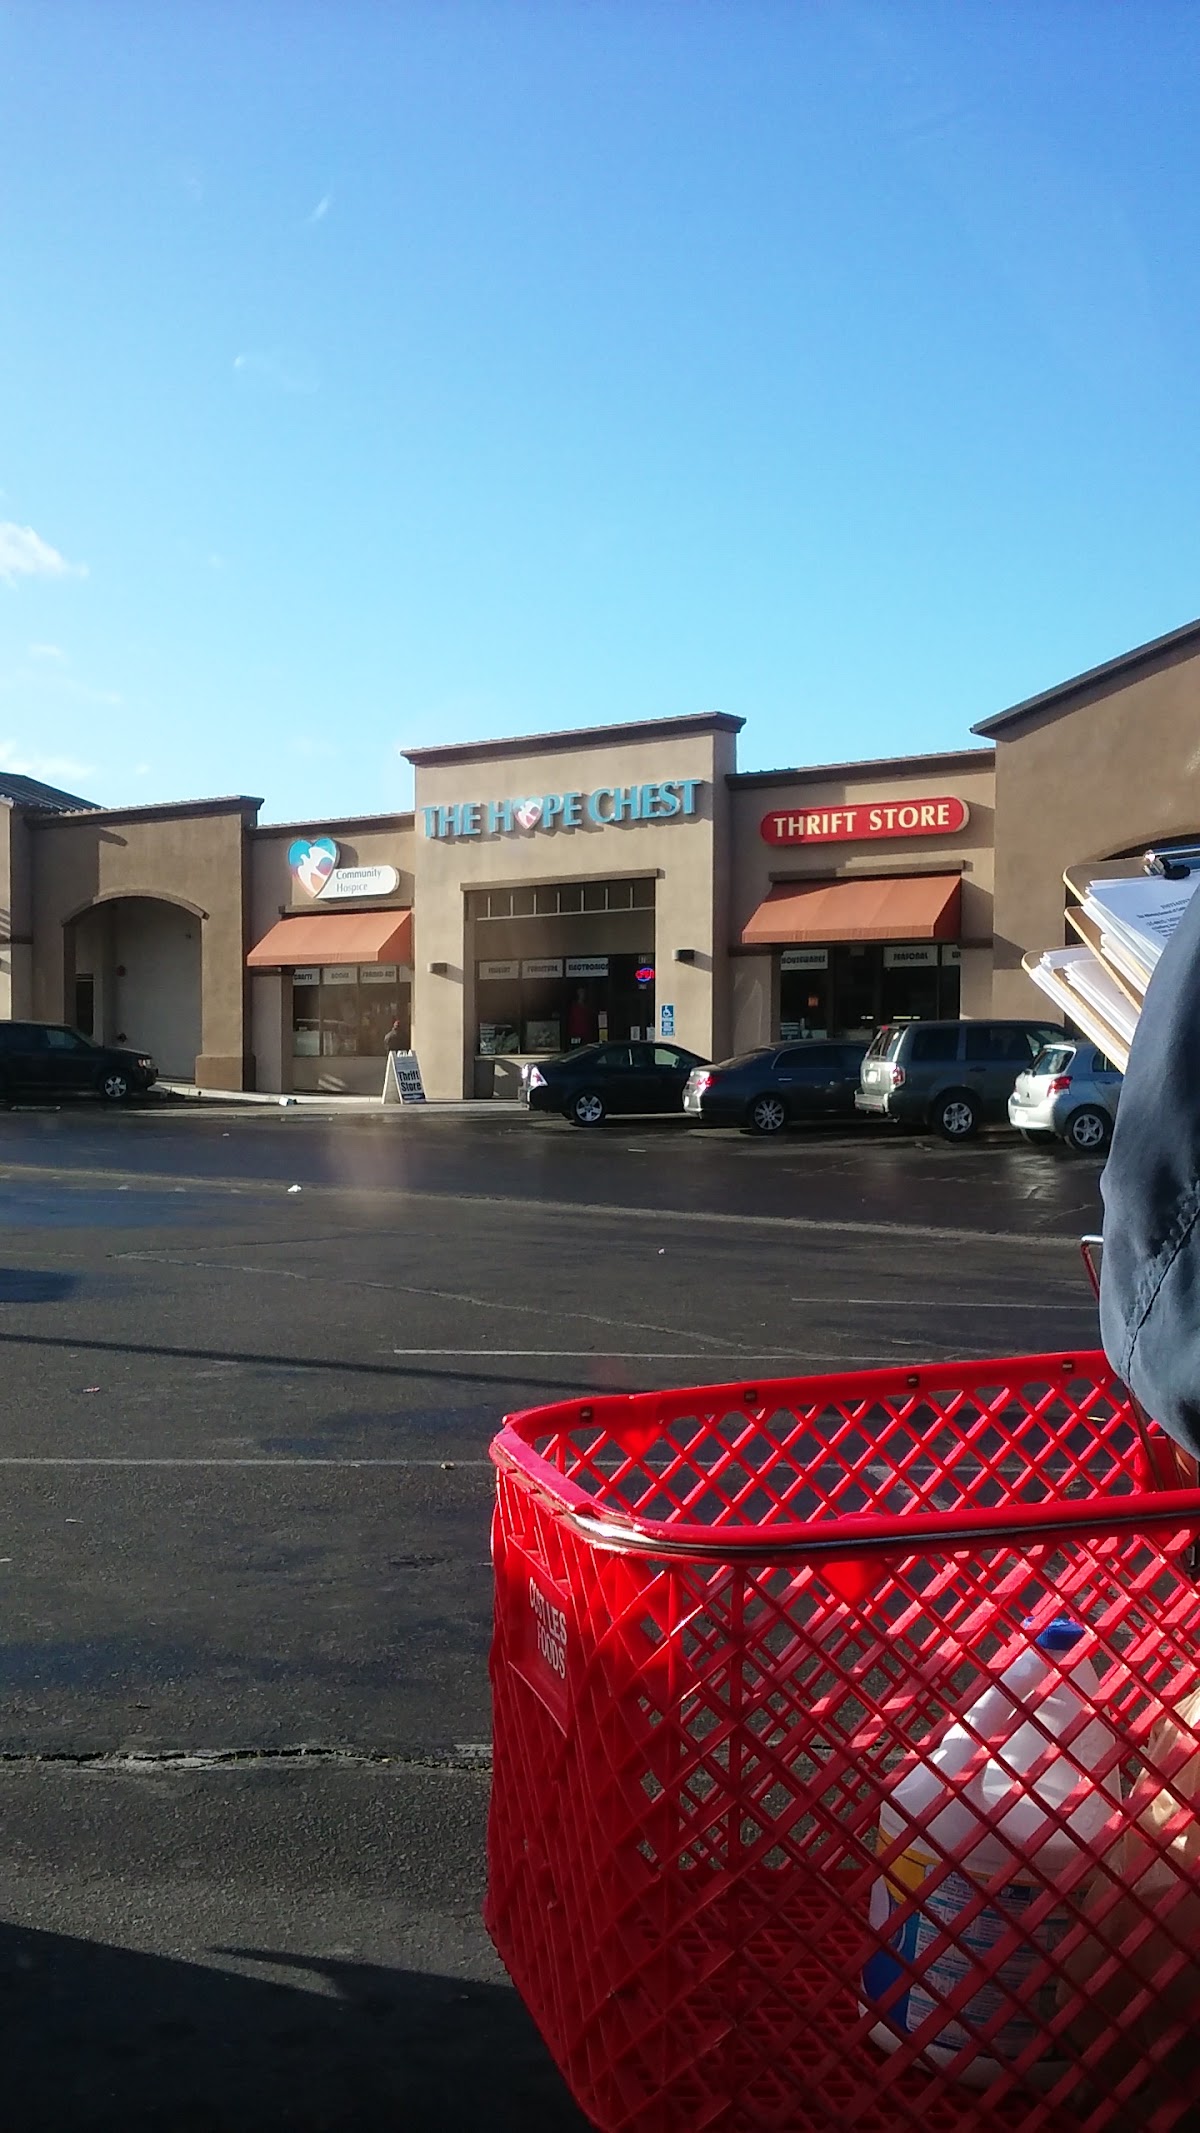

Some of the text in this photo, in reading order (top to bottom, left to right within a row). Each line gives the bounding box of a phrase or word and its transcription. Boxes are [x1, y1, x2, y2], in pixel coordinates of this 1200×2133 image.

[421, 778, 702, 838] THE HOPE CHEST
[773, 804, 950, 838] THRIFT STORE
[336, 868, 381, 881] Community
[336, 883, 368, 894] Hospice
[398, 1070, 420, 1082] Thrift
[401, 1082, 422, 1092] Store
[537, 1619, 566, 1680] FOODS
